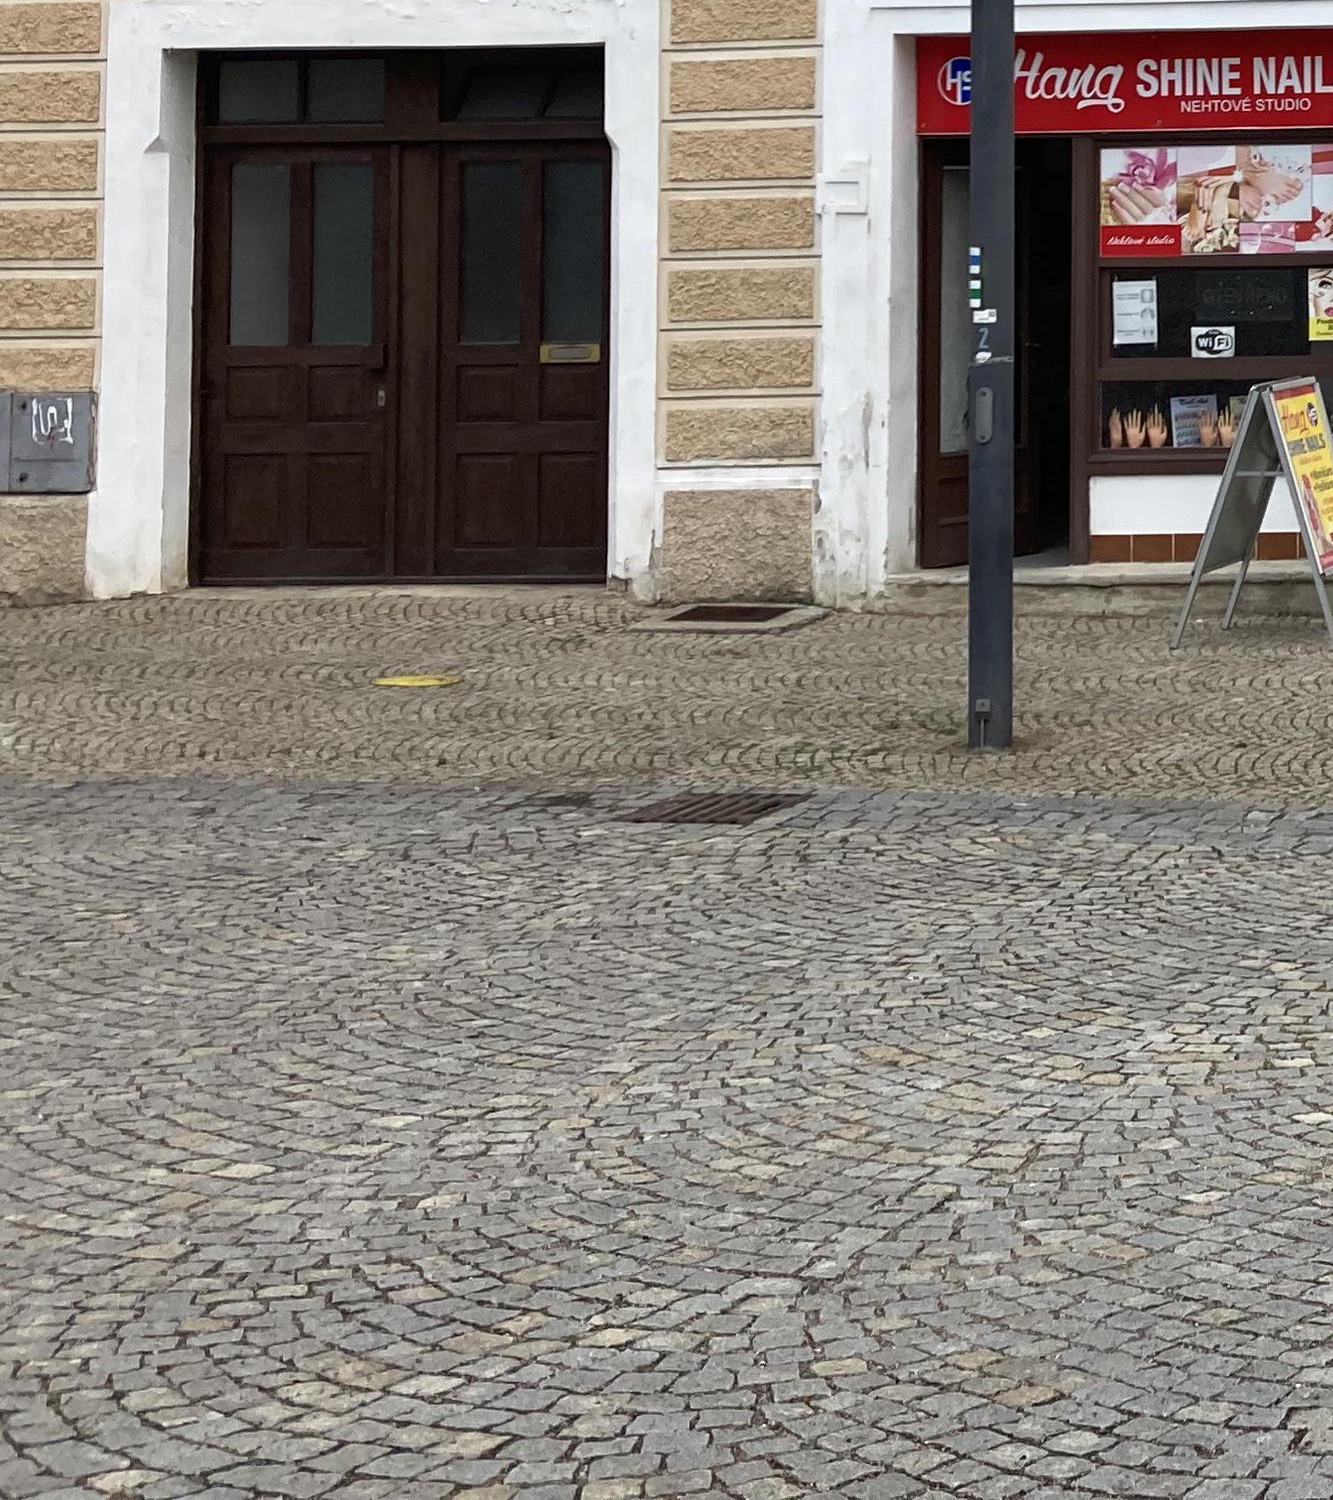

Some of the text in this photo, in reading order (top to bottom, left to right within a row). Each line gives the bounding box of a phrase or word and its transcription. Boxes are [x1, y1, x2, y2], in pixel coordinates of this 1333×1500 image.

[1013, 49, 1124, 112] Hang
[1136, 58, 1241, 98] SHINE
[1180, 97, 1311, 113] NEHTOVÉ STUDIO
[979, 328, 989, 349] 2
